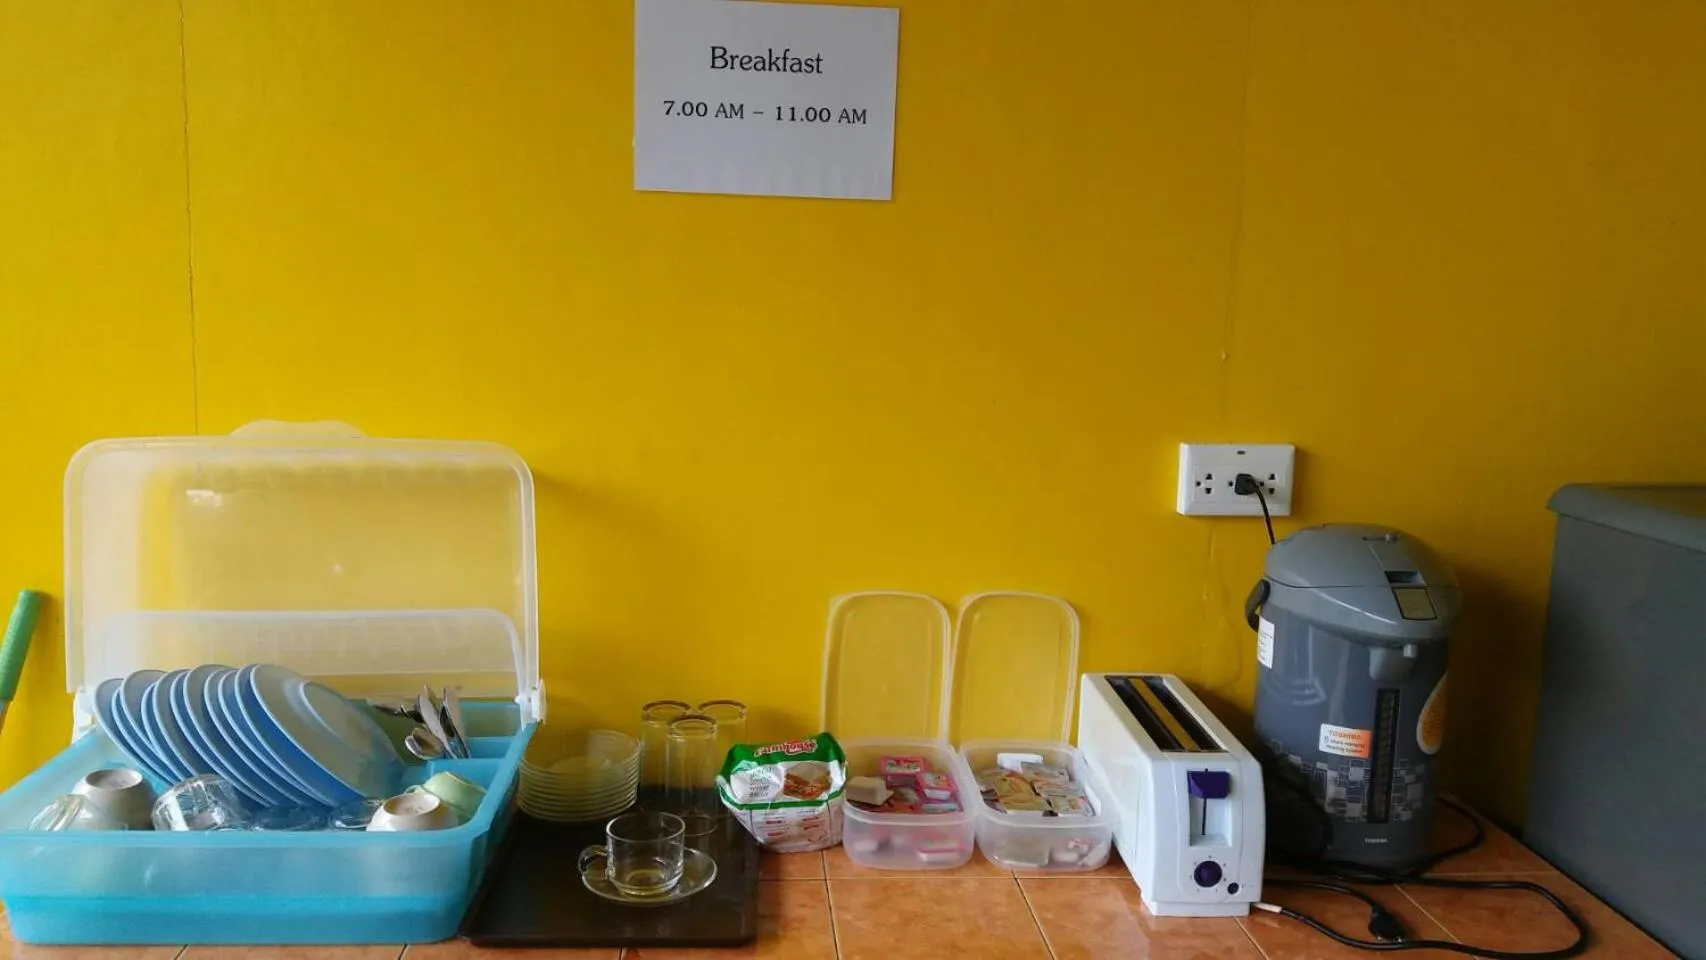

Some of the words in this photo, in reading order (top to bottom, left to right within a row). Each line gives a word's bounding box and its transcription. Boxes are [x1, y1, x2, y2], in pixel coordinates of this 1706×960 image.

[710, 46, 823, 74] Breakfast
[663, 101, 708, 117] 7.00
[714, 102, 744, 119] AM
[775, 106, 831, 122] 11.00
[838, 108, 867, 124] AM
